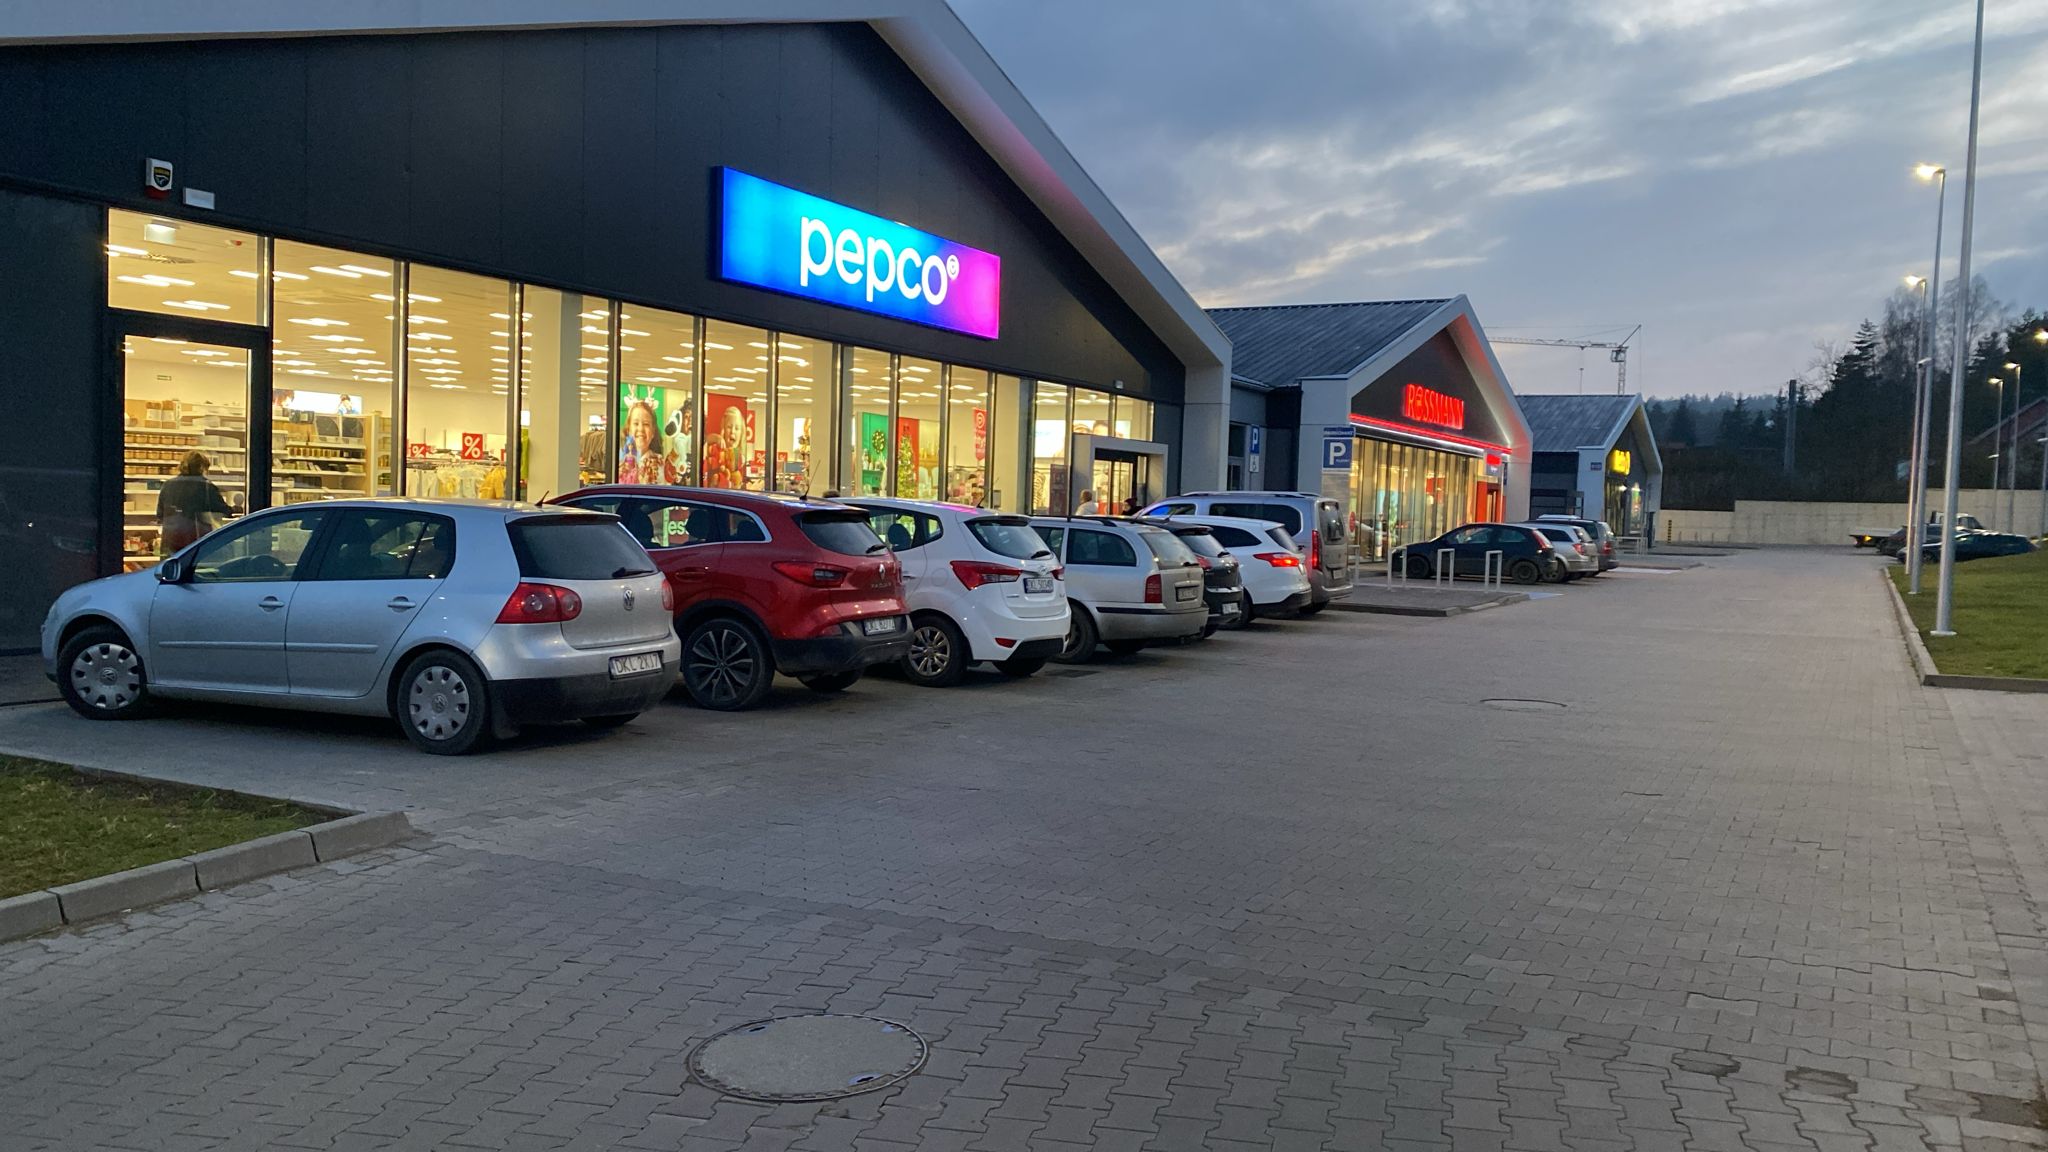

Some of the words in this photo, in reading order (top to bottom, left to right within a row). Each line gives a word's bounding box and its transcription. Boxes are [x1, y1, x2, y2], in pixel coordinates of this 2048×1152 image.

[800, 216, 948, 306] pepco
[1405, 384, 1464, 429] ROSSMANN
[1252, 428, 1259, 451] P
[1329, 442, 1347, 466] P
[615, 657, 637, 673] DKL
